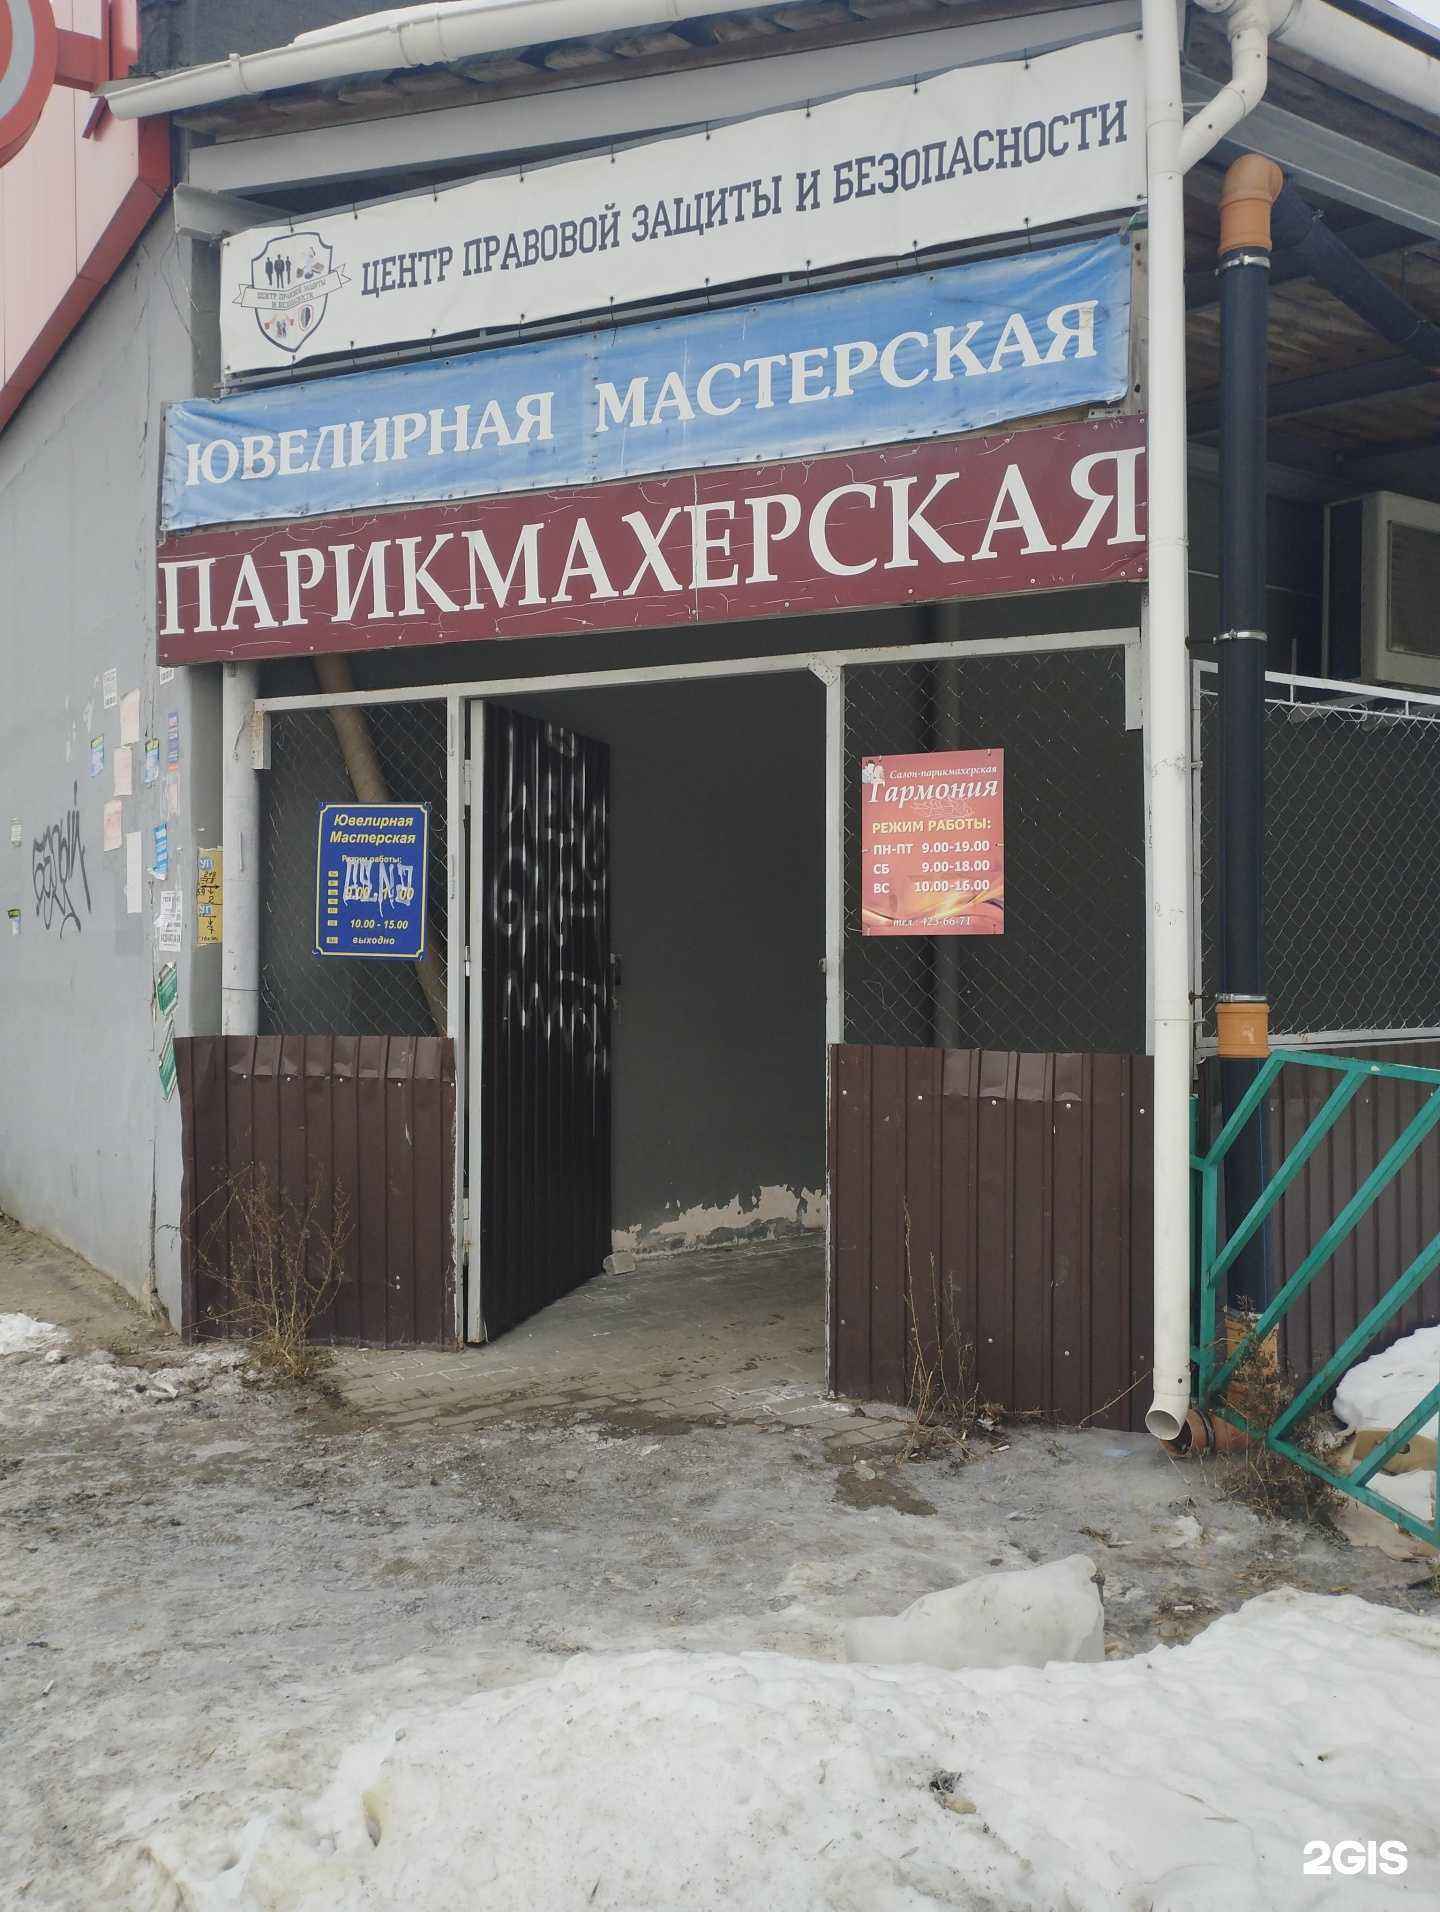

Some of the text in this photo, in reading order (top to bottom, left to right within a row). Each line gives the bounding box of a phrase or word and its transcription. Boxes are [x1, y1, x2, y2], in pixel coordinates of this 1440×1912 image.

[361, 99, 1128, 298] ЦЕНТР ПРАВОВОЙ ЗАЩИТЫ И БЕЗОПАСНОСТИ
[184, 298, 1098, 487] ЮВЕЛИРНАЯ МАСТЕРСКАЯ
[159, 446, 1147, 636] ПАРИКМАХЕРСКАЯ
[889, 766, 998, 780] Салон-парикмахерская
[867, 780, 998, 809] Гармония
[333, 813, 414, 829] Ювелирная
[871, 817, 992, 834] РЕЖИМ РАБОТЫ:
[329, 831, 417, 846] Мастерская
[873, 840, 990, 855] ПН-ПТ 9.00-19.00
[873, 859, 990, 875] СБ 9.00-18.00
[873, 882, 890, 894] ВС
